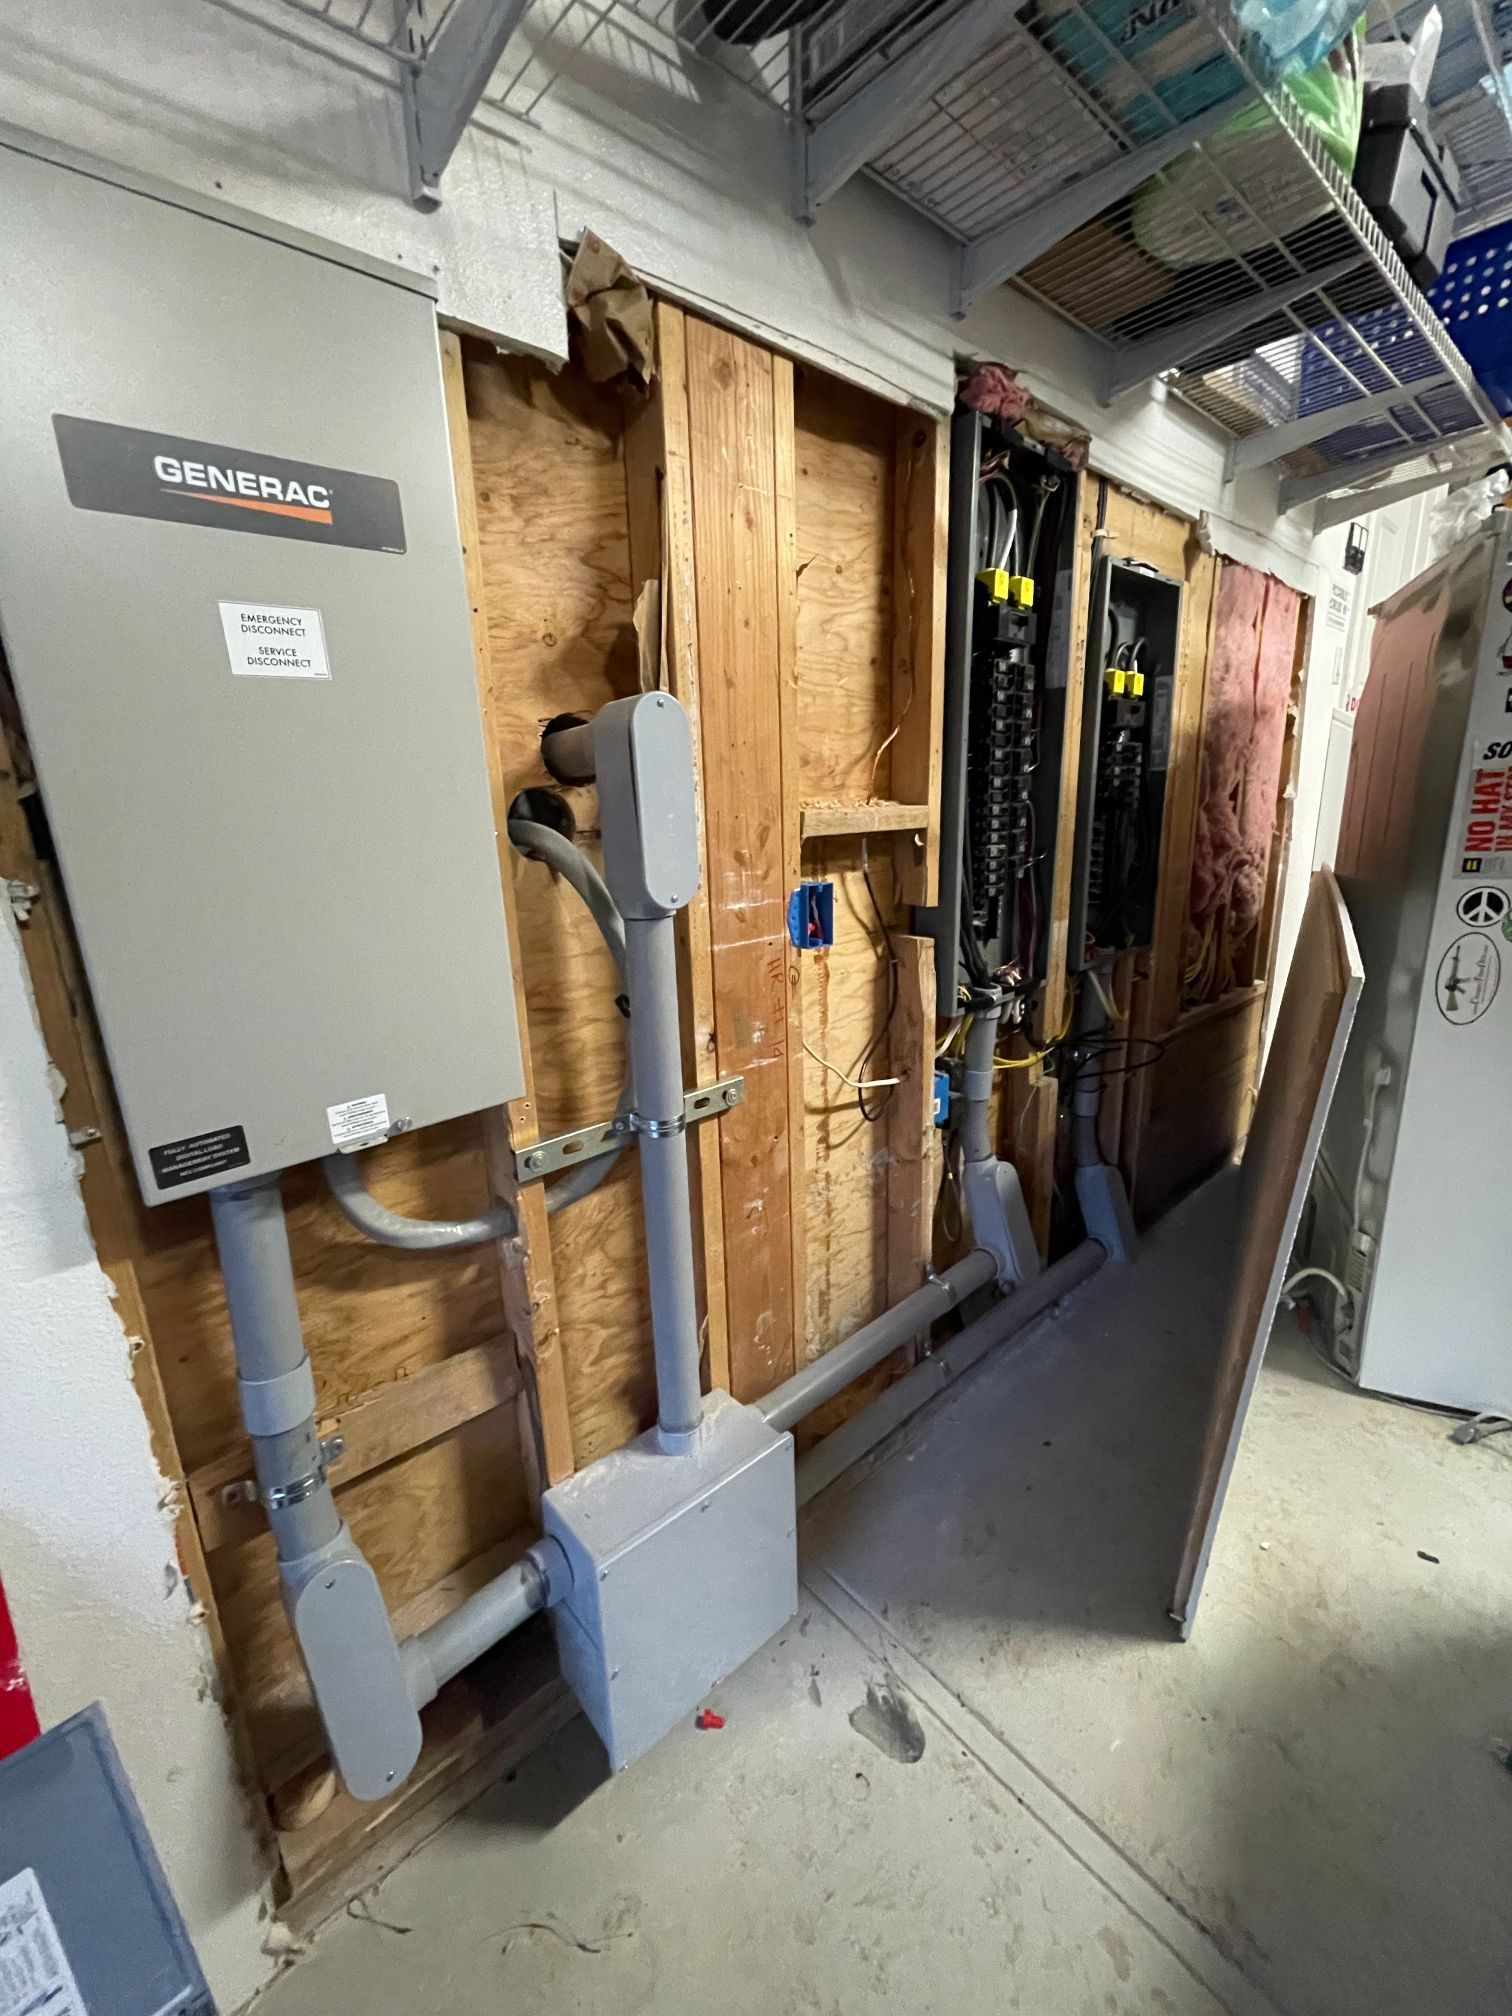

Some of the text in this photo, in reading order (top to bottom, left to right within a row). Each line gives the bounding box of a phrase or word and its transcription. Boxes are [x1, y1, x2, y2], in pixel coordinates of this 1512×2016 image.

[154, 455, 331, 509] GENERAC
[240, 613, 303, 627] EMERGENCY
[240, 624, 306, 638] DISCONNECT
[258, 646, 298, 658] SERVICE
[247, 656, 312, 669] DISCONNECT
[1470, 768, 1506, 814] HAT
[1465, 818, 1496, 853] NO
